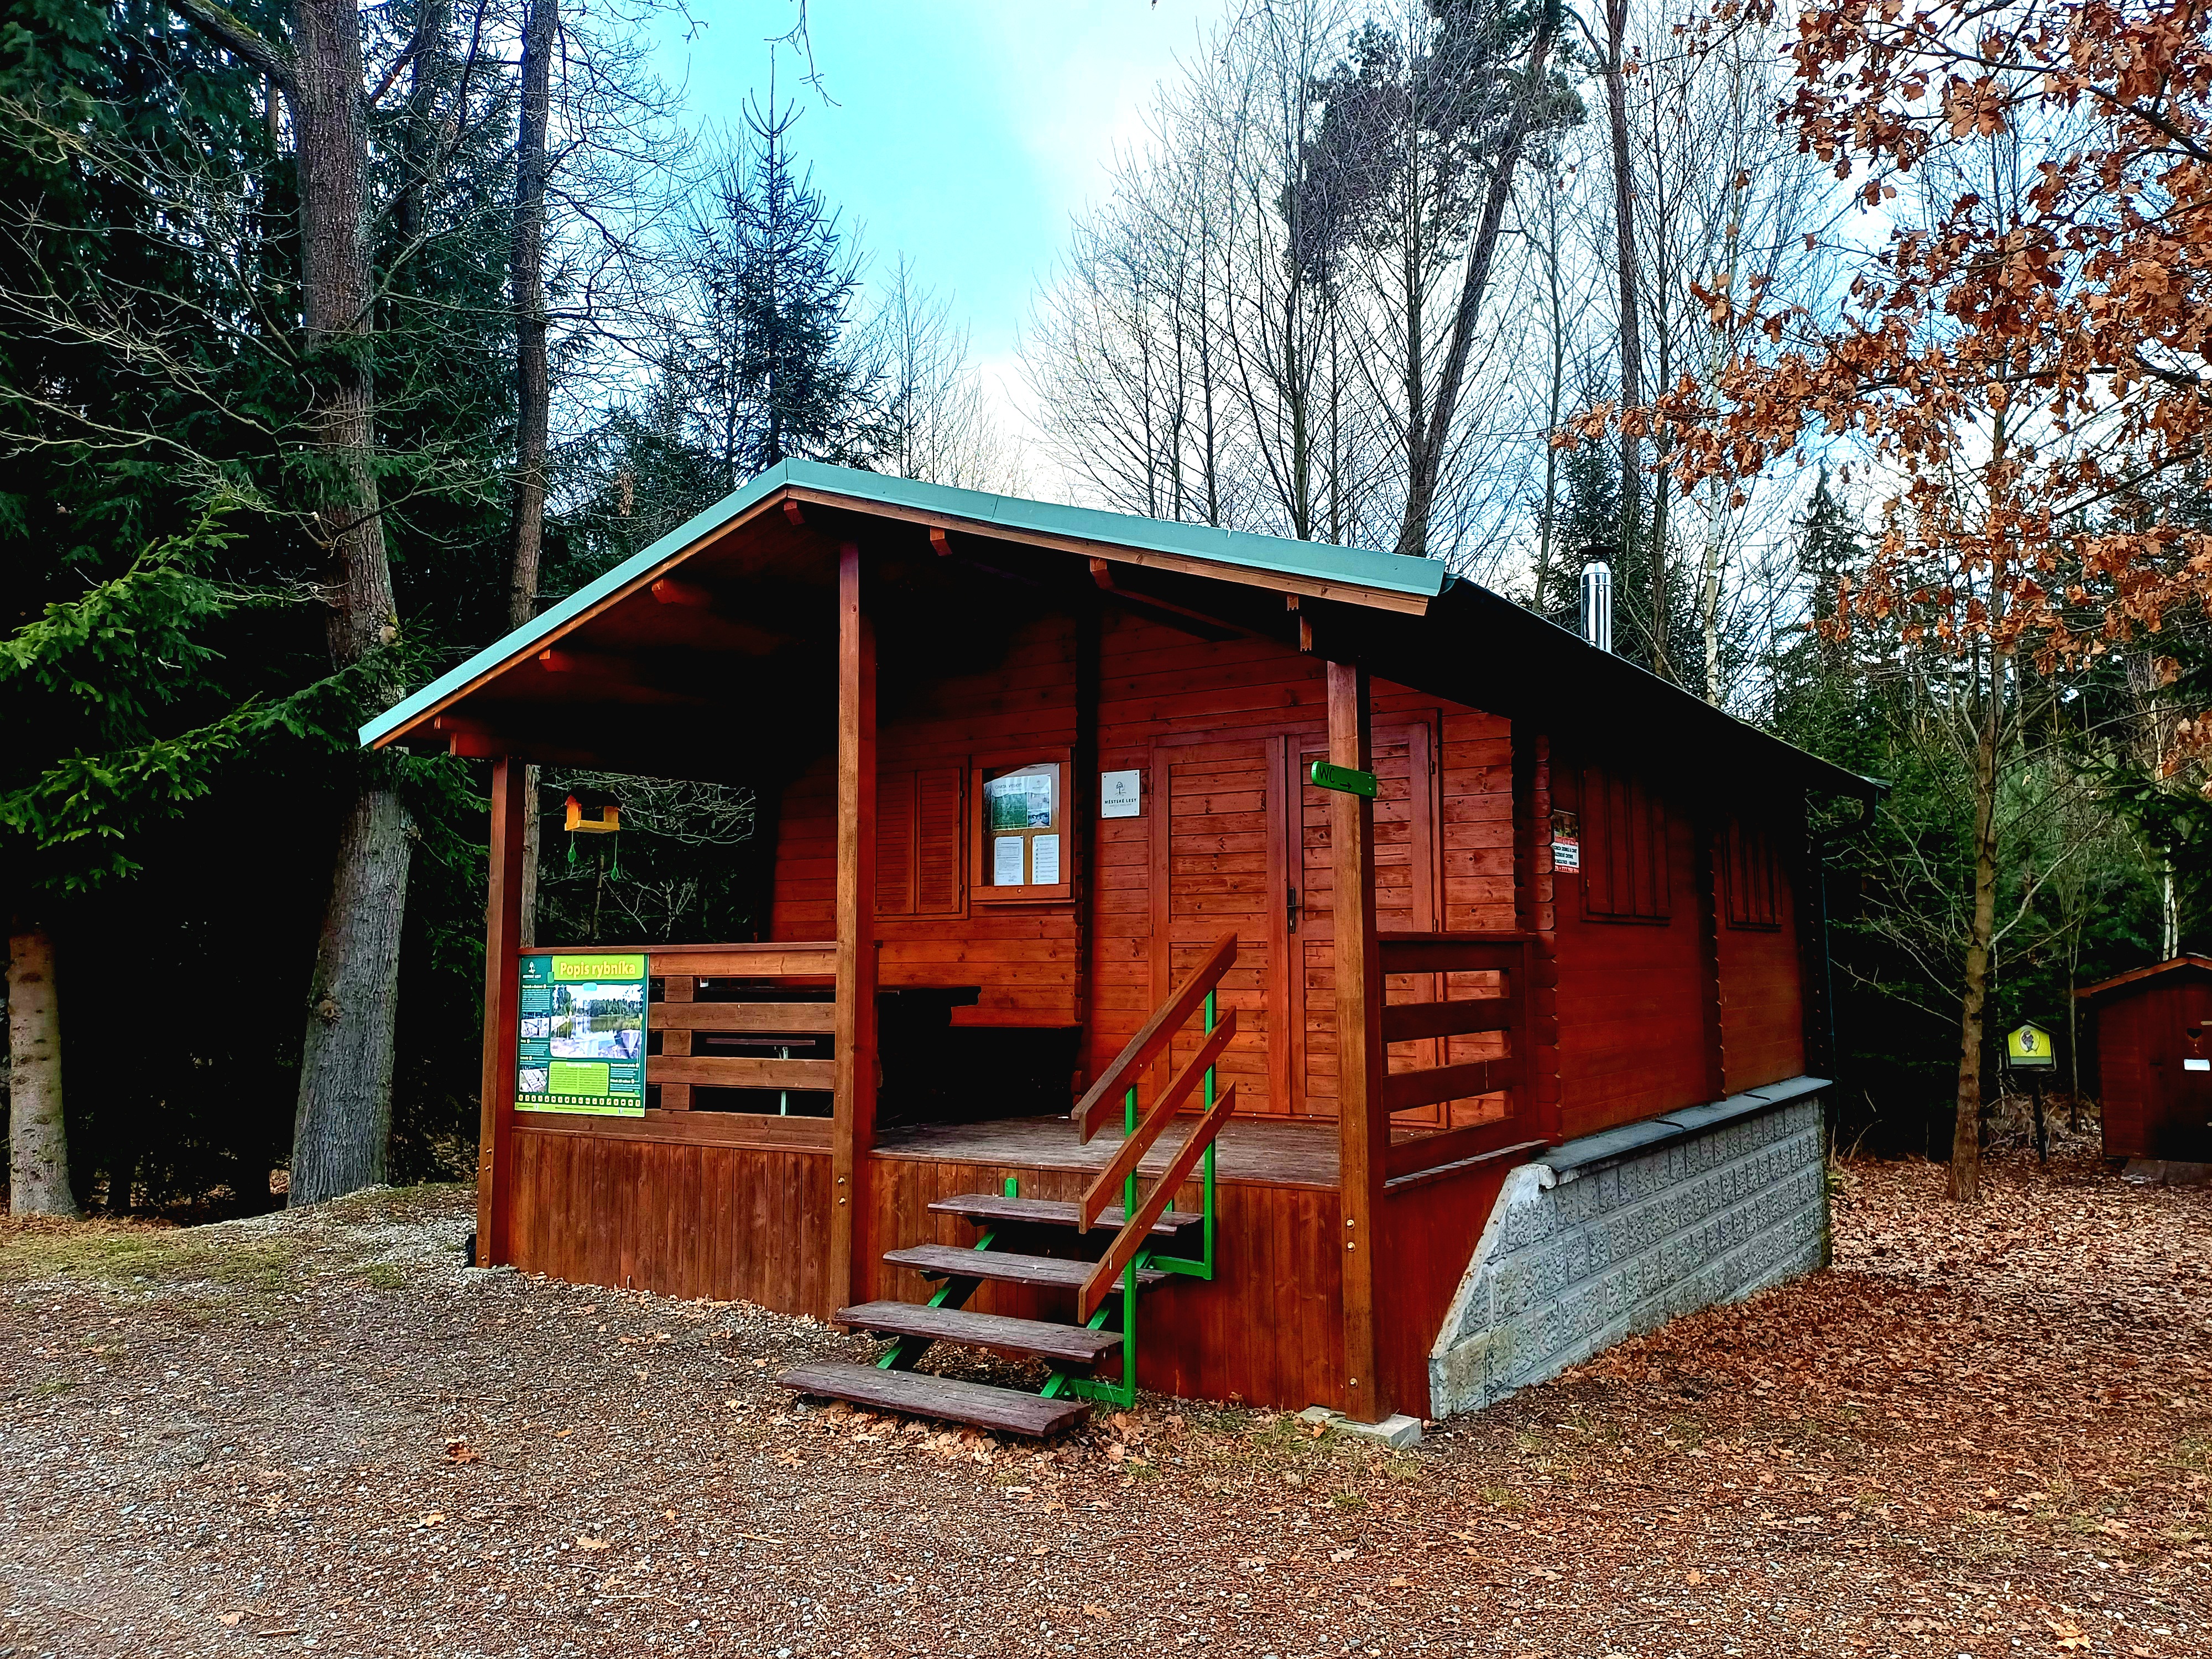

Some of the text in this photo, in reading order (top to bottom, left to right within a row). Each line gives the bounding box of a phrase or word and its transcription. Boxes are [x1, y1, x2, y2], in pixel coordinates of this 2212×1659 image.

[1319, 765, 1335, 784] WC
[560, 961, 635, 978] Popis rybníka
